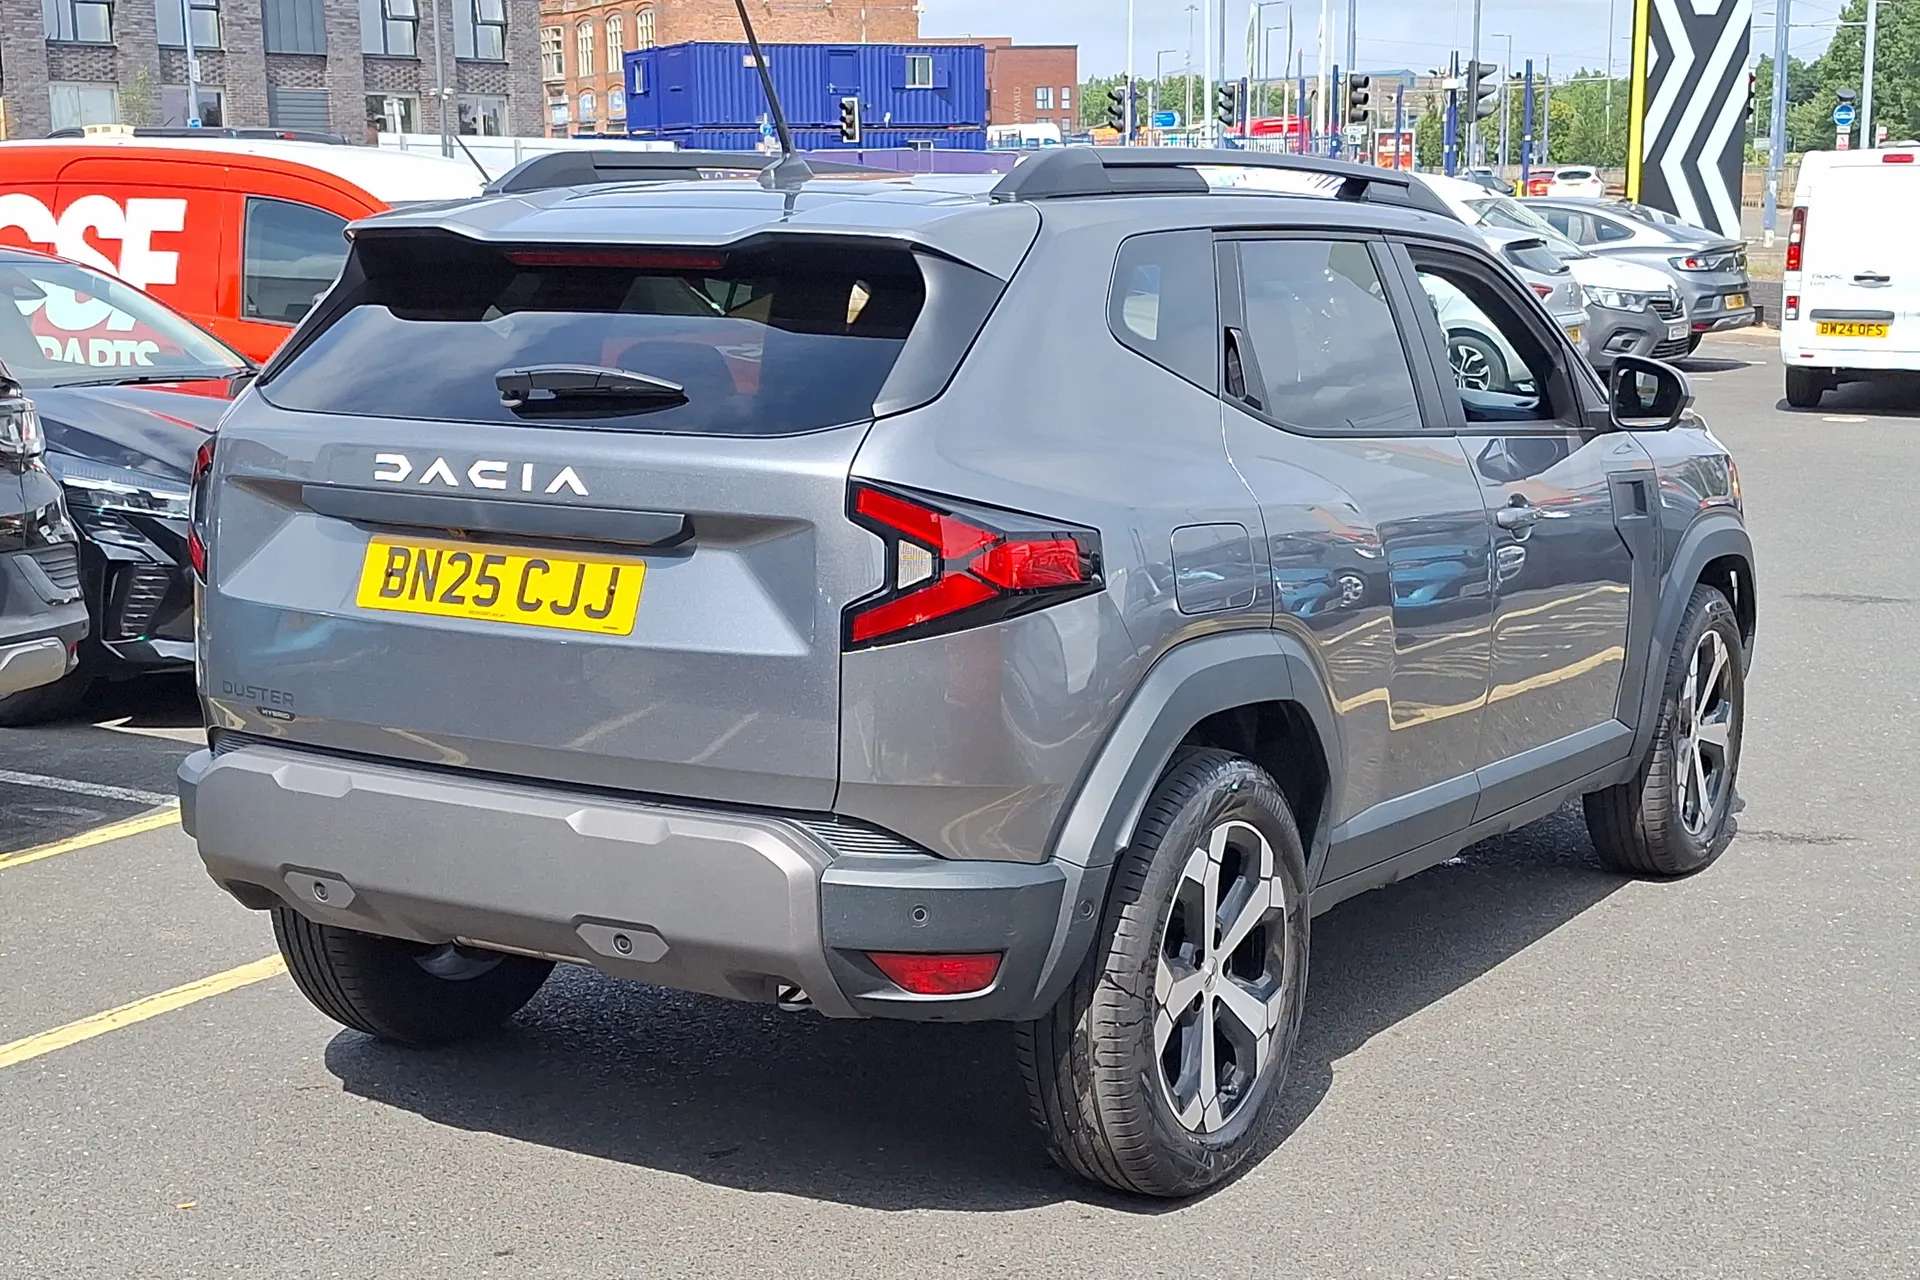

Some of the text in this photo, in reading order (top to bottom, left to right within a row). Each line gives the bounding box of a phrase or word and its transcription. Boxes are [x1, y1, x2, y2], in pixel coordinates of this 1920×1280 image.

[1820, 322, 1853, 335] BW24
[374, 453, 589, 496] DACIA
[379, 546, 620, 620] BN25 CJJ
[223, 680, 294, 707] DUSTER
